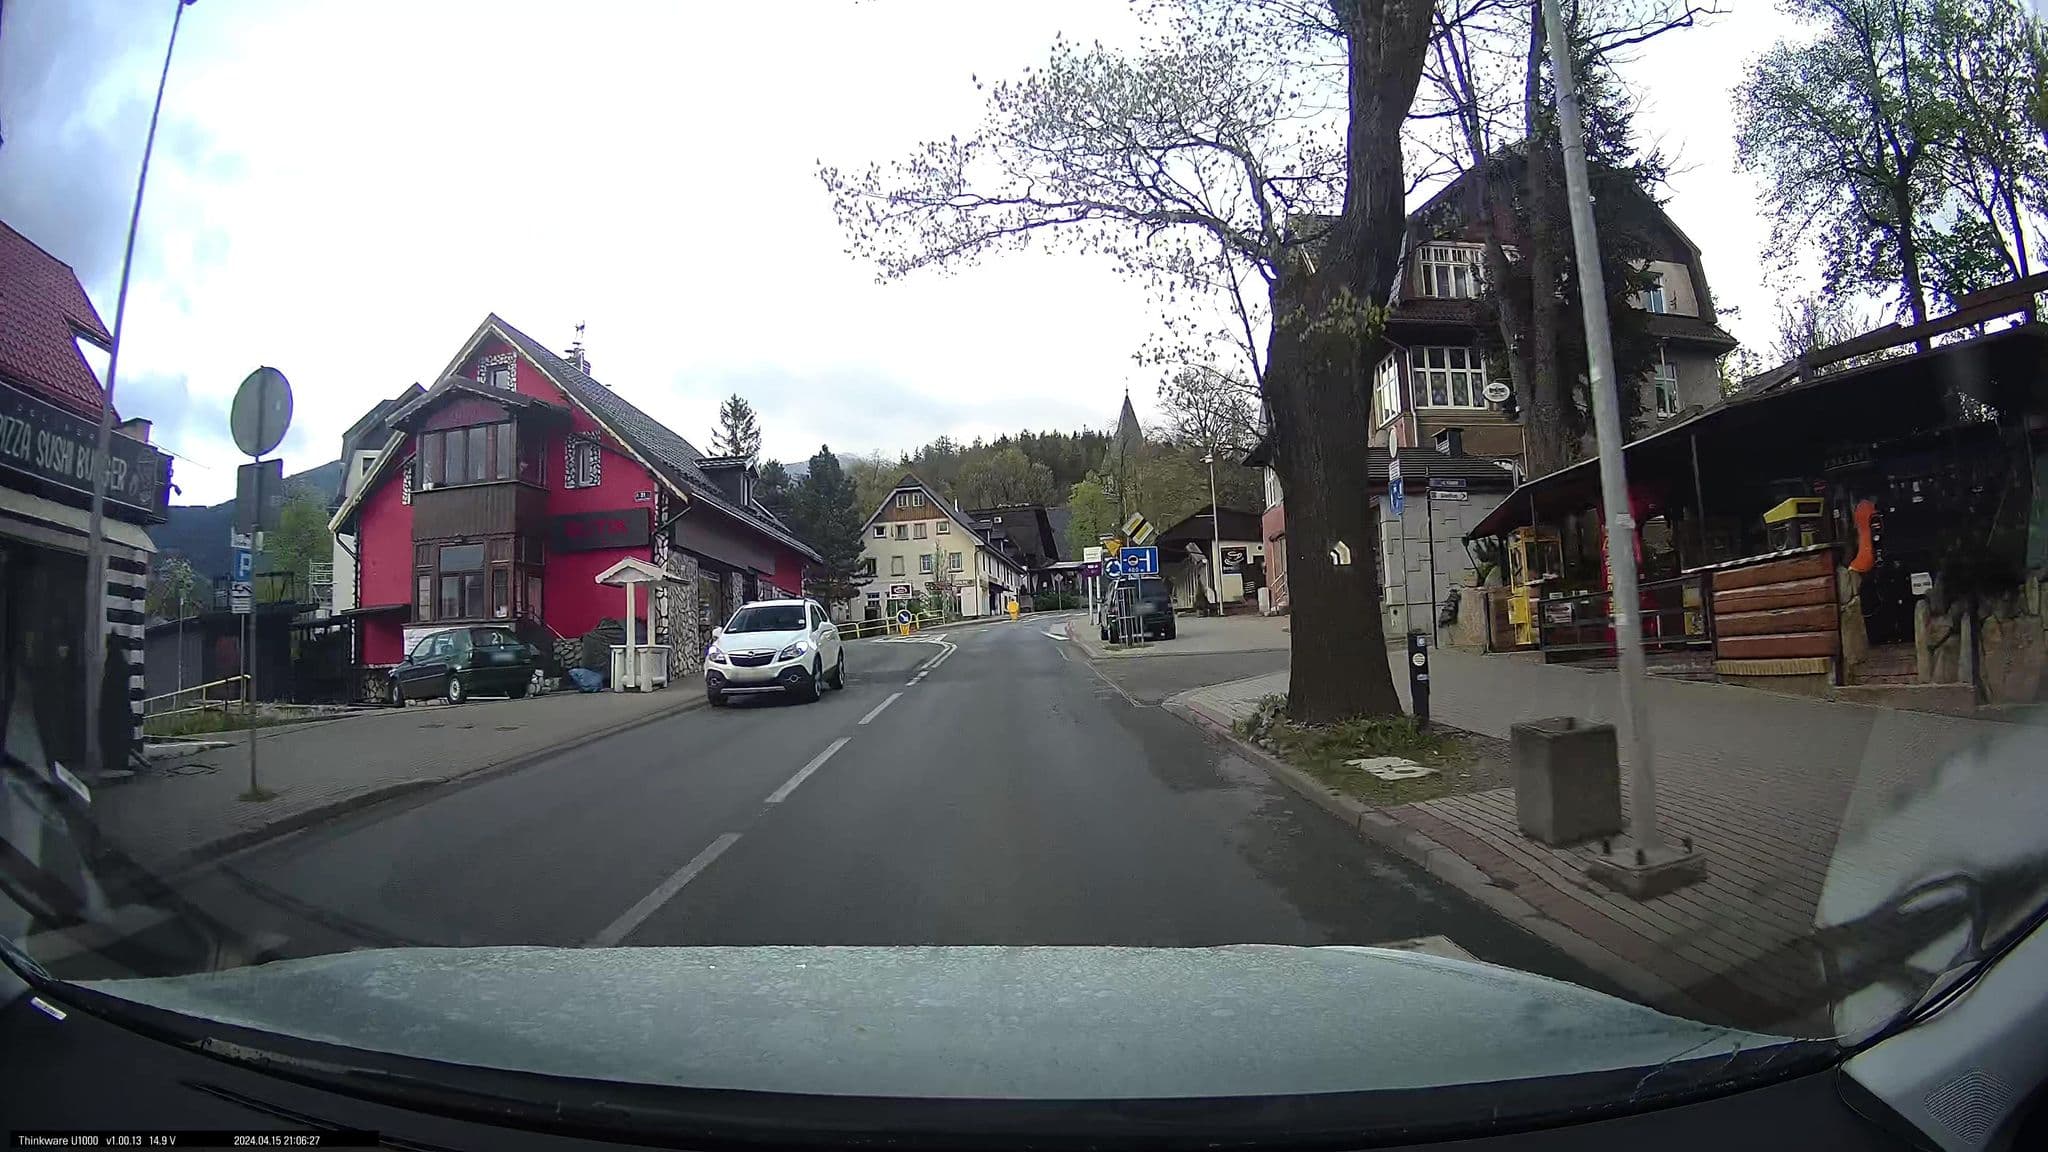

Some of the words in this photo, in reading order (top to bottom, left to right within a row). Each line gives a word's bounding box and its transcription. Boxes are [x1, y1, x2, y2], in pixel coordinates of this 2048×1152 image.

[36, 429, 74, 474] SUSHI
[76, 444, 128, 490] BUGER
[240, 553, 252, 576] P
